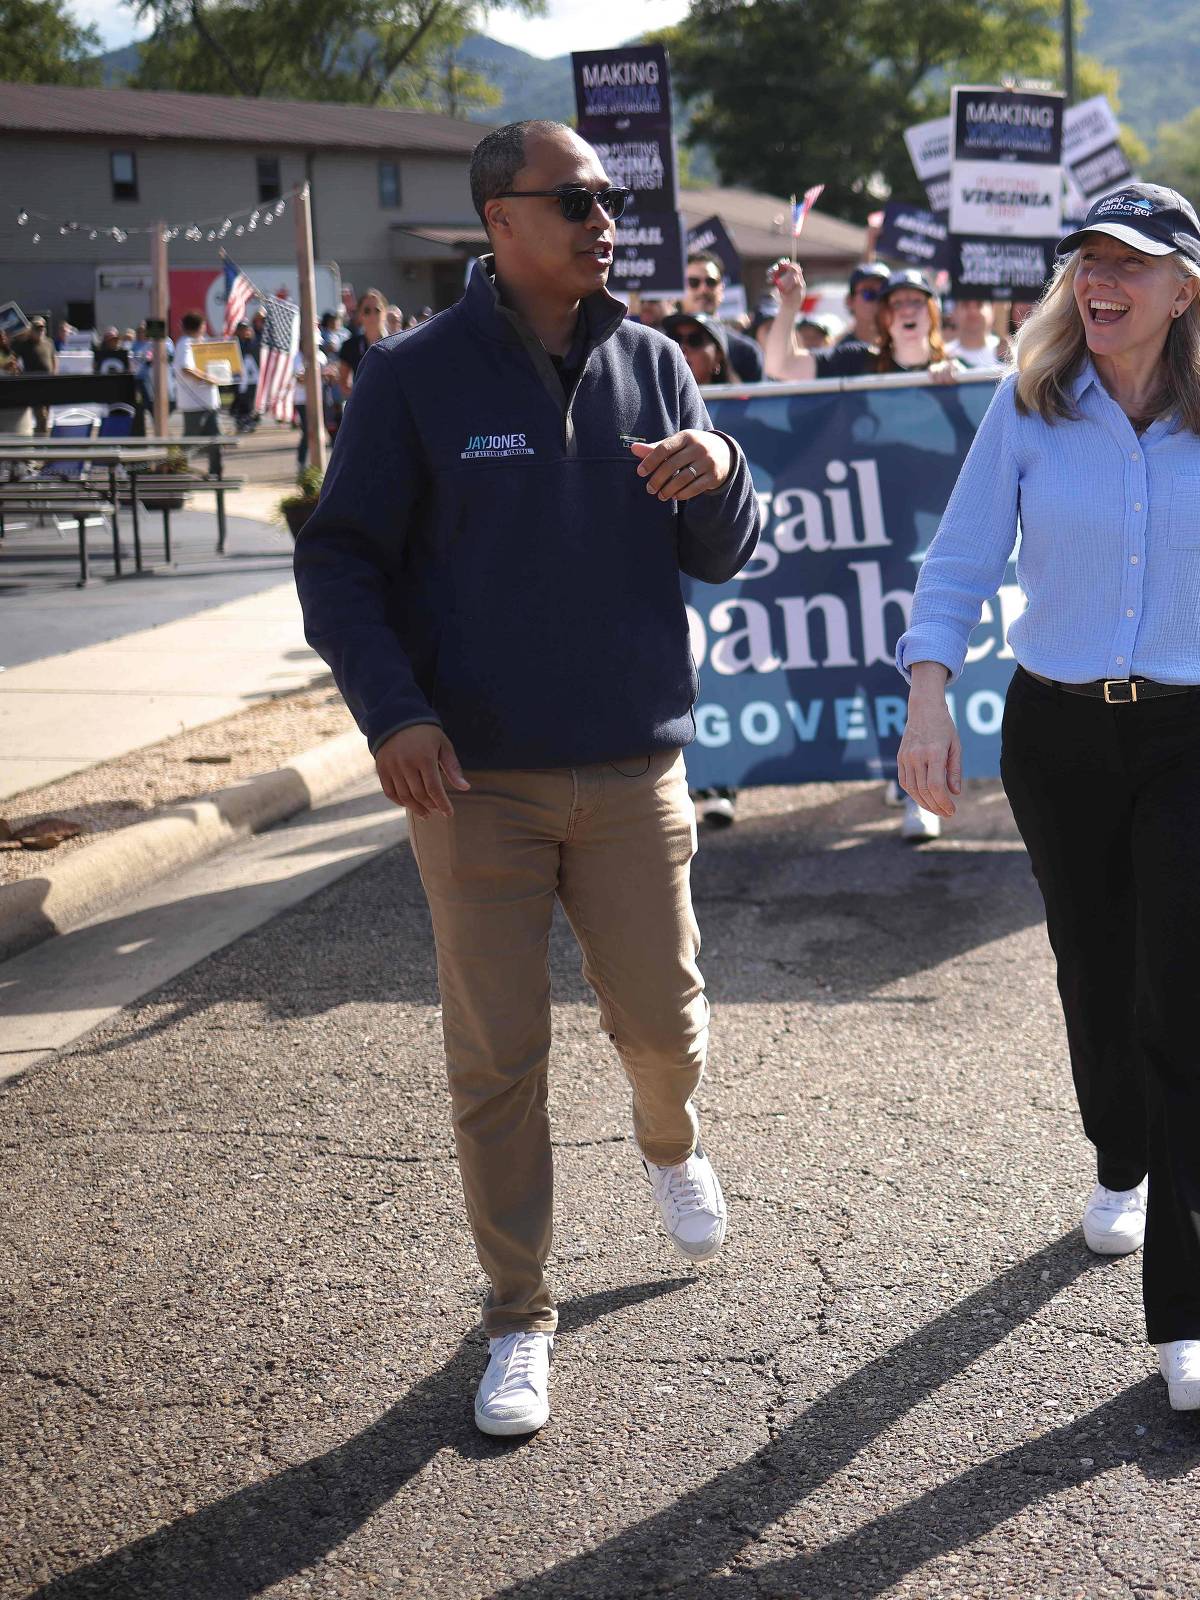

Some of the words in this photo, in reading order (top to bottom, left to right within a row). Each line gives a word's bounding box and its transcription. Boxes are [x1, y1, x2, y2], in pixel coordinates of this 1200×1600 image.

[582, 61, 659, 88] MAKING
[965, 102, 1054, 128] MAKING
[961, 188, 1052, 209] VIRGINIA
[1095, 202, 1152, 217] Spanberger
[733, 458, 893, 581] gail
[695, 690, 1005, 748] GOVERO
